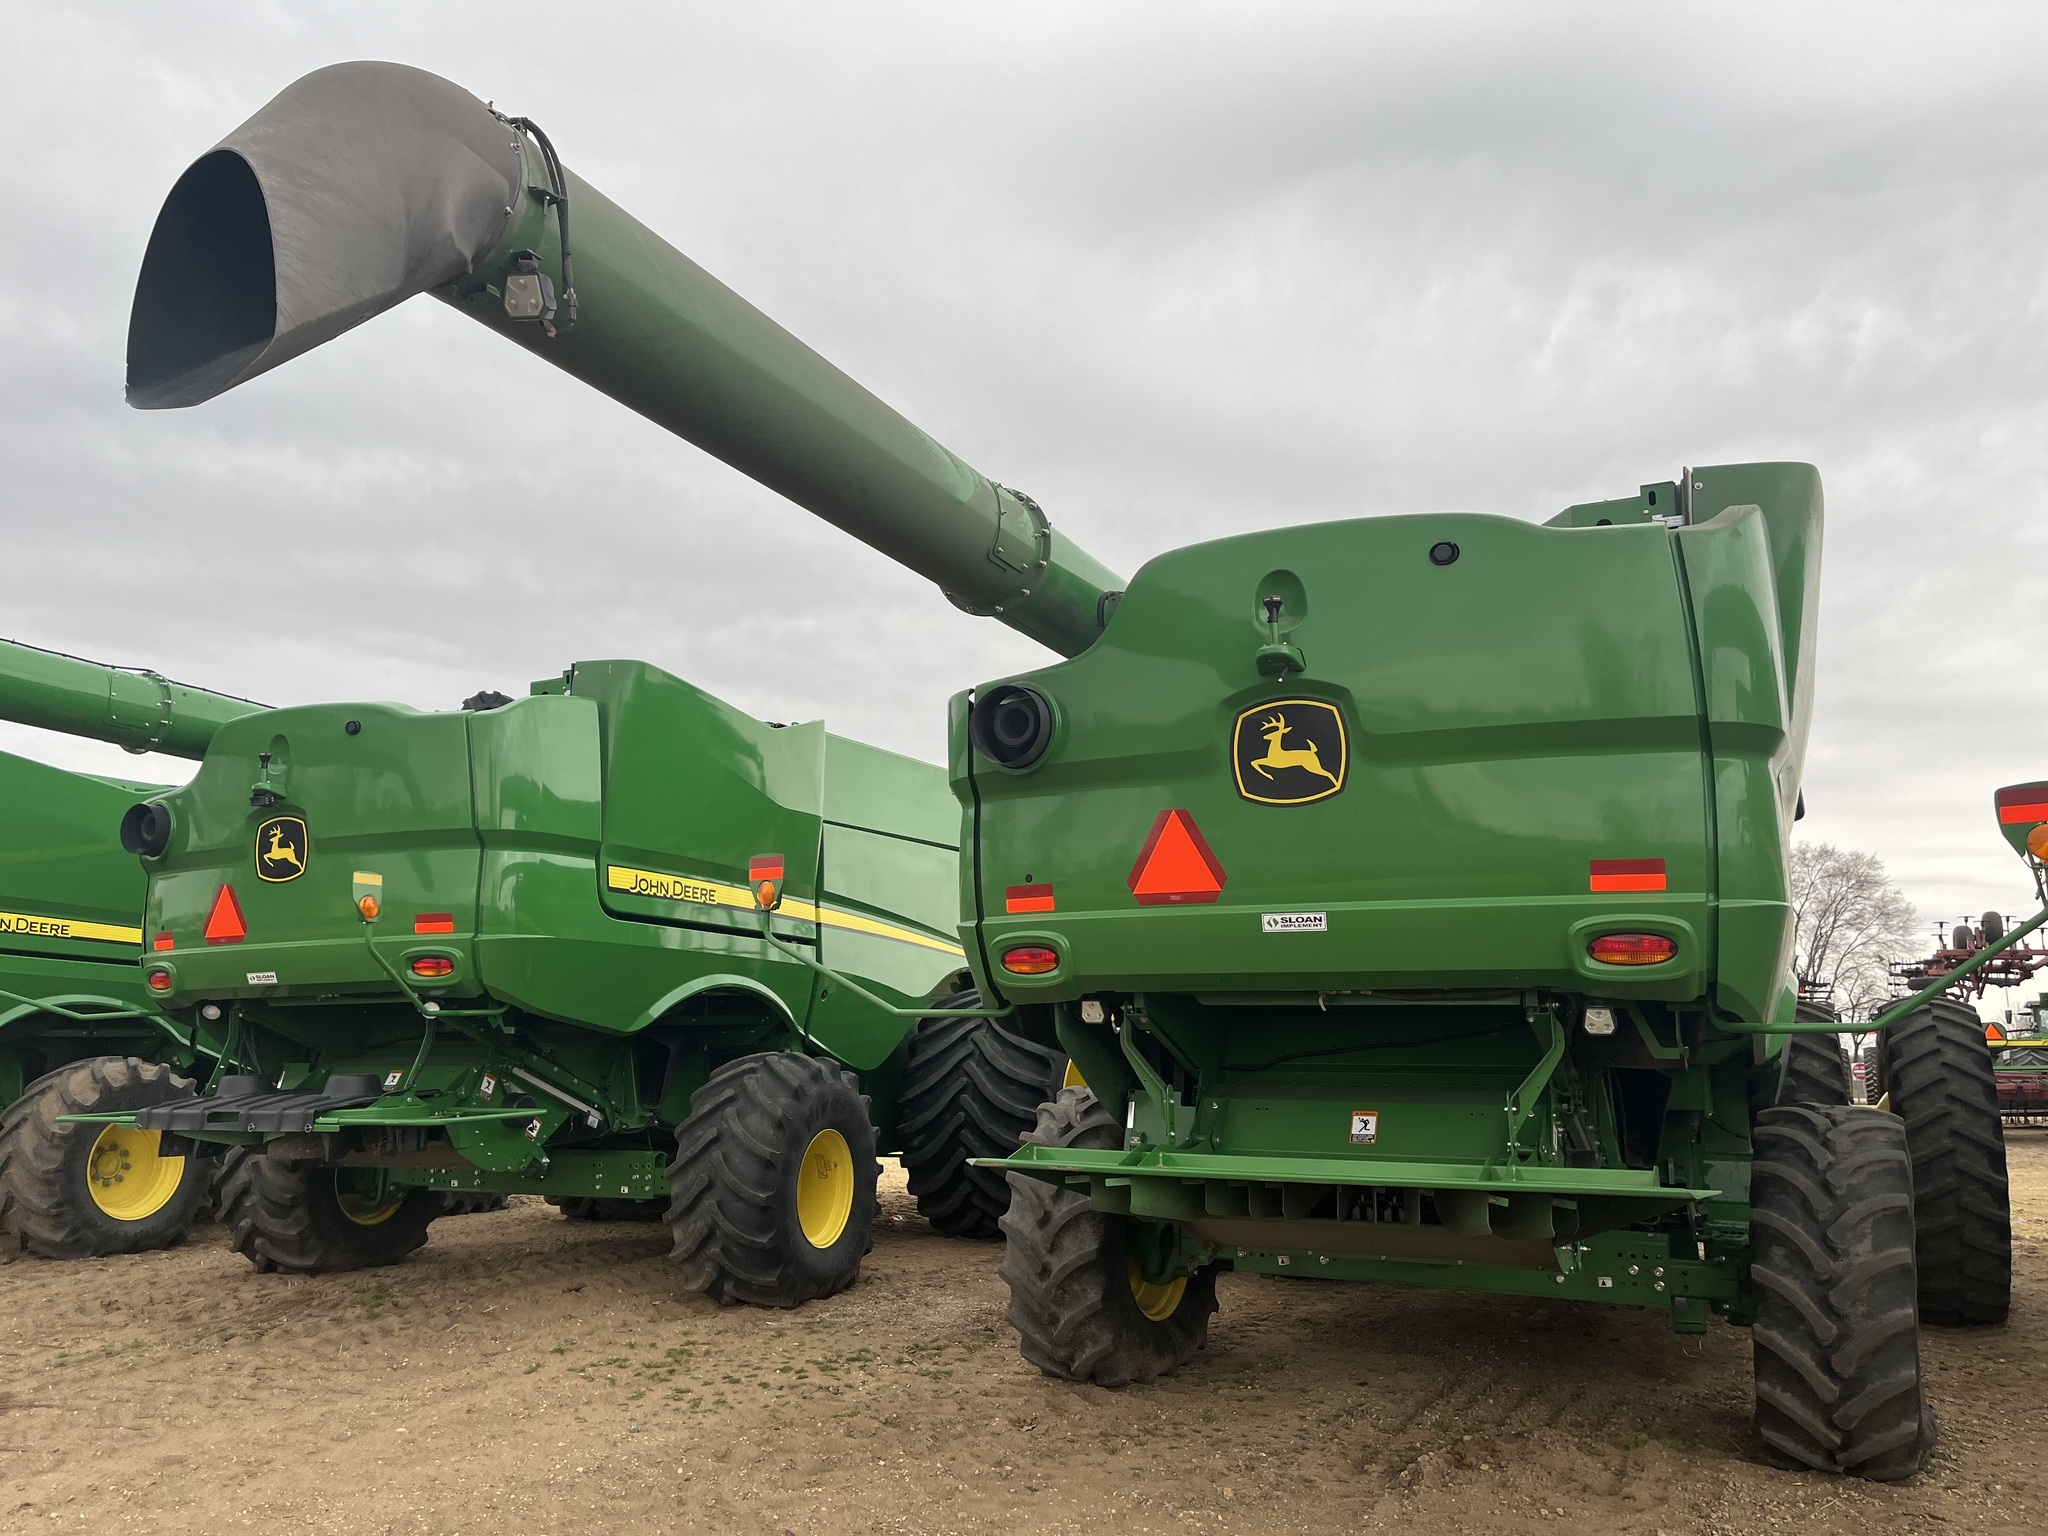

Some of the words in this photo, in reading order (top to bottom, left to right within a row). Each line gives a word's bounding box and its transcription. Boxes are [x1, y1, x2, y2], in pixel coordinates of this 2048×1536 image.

[630, 874, 669, 896] JOHN
[673, 880, 717, 902] DEERE
[16, 917, 71, 936] DEERE
[1280, 916, 1323, 924] SLOAN
